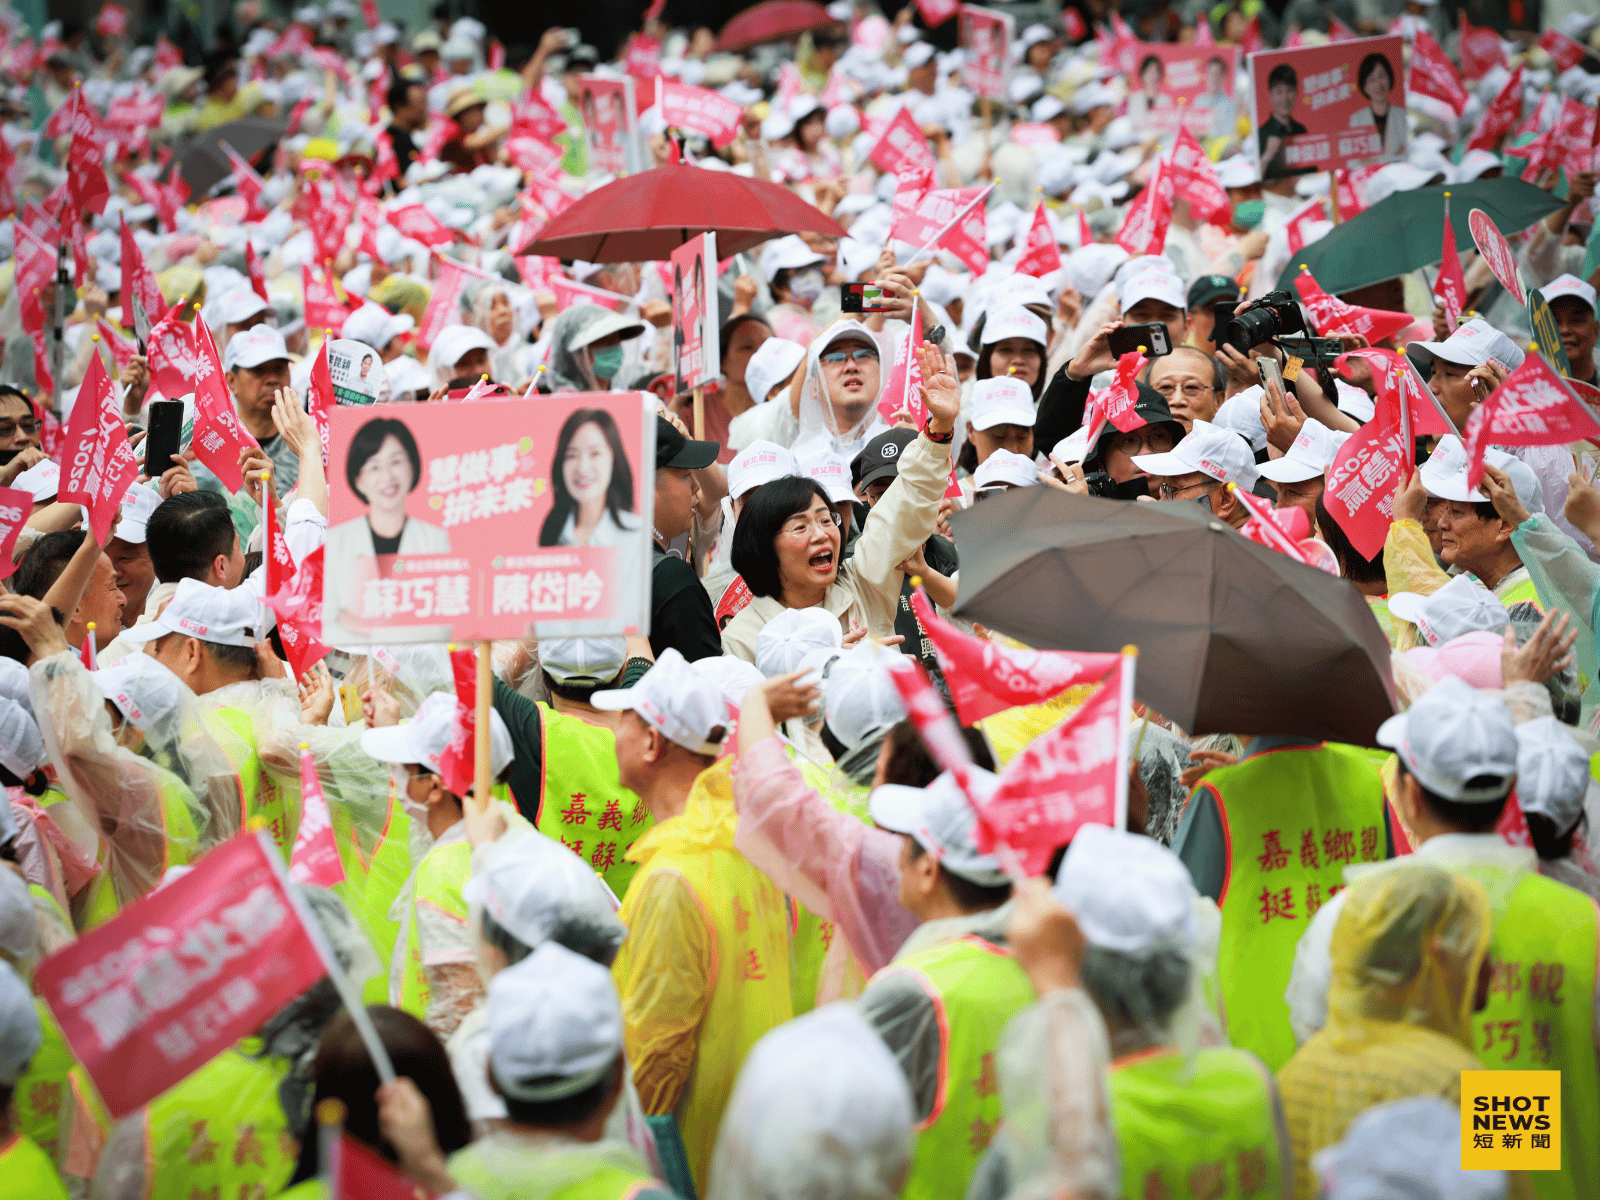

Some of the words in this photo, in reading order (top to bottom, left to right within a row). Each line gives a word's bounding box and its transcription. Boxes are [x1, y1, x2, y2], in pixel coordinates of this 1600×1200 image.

[362, 574, 471, 619] 蘇巧慧
[492, 569, 605, 616] 陳岱吟
[1258, 883, 1346, 925] 挺蘇
